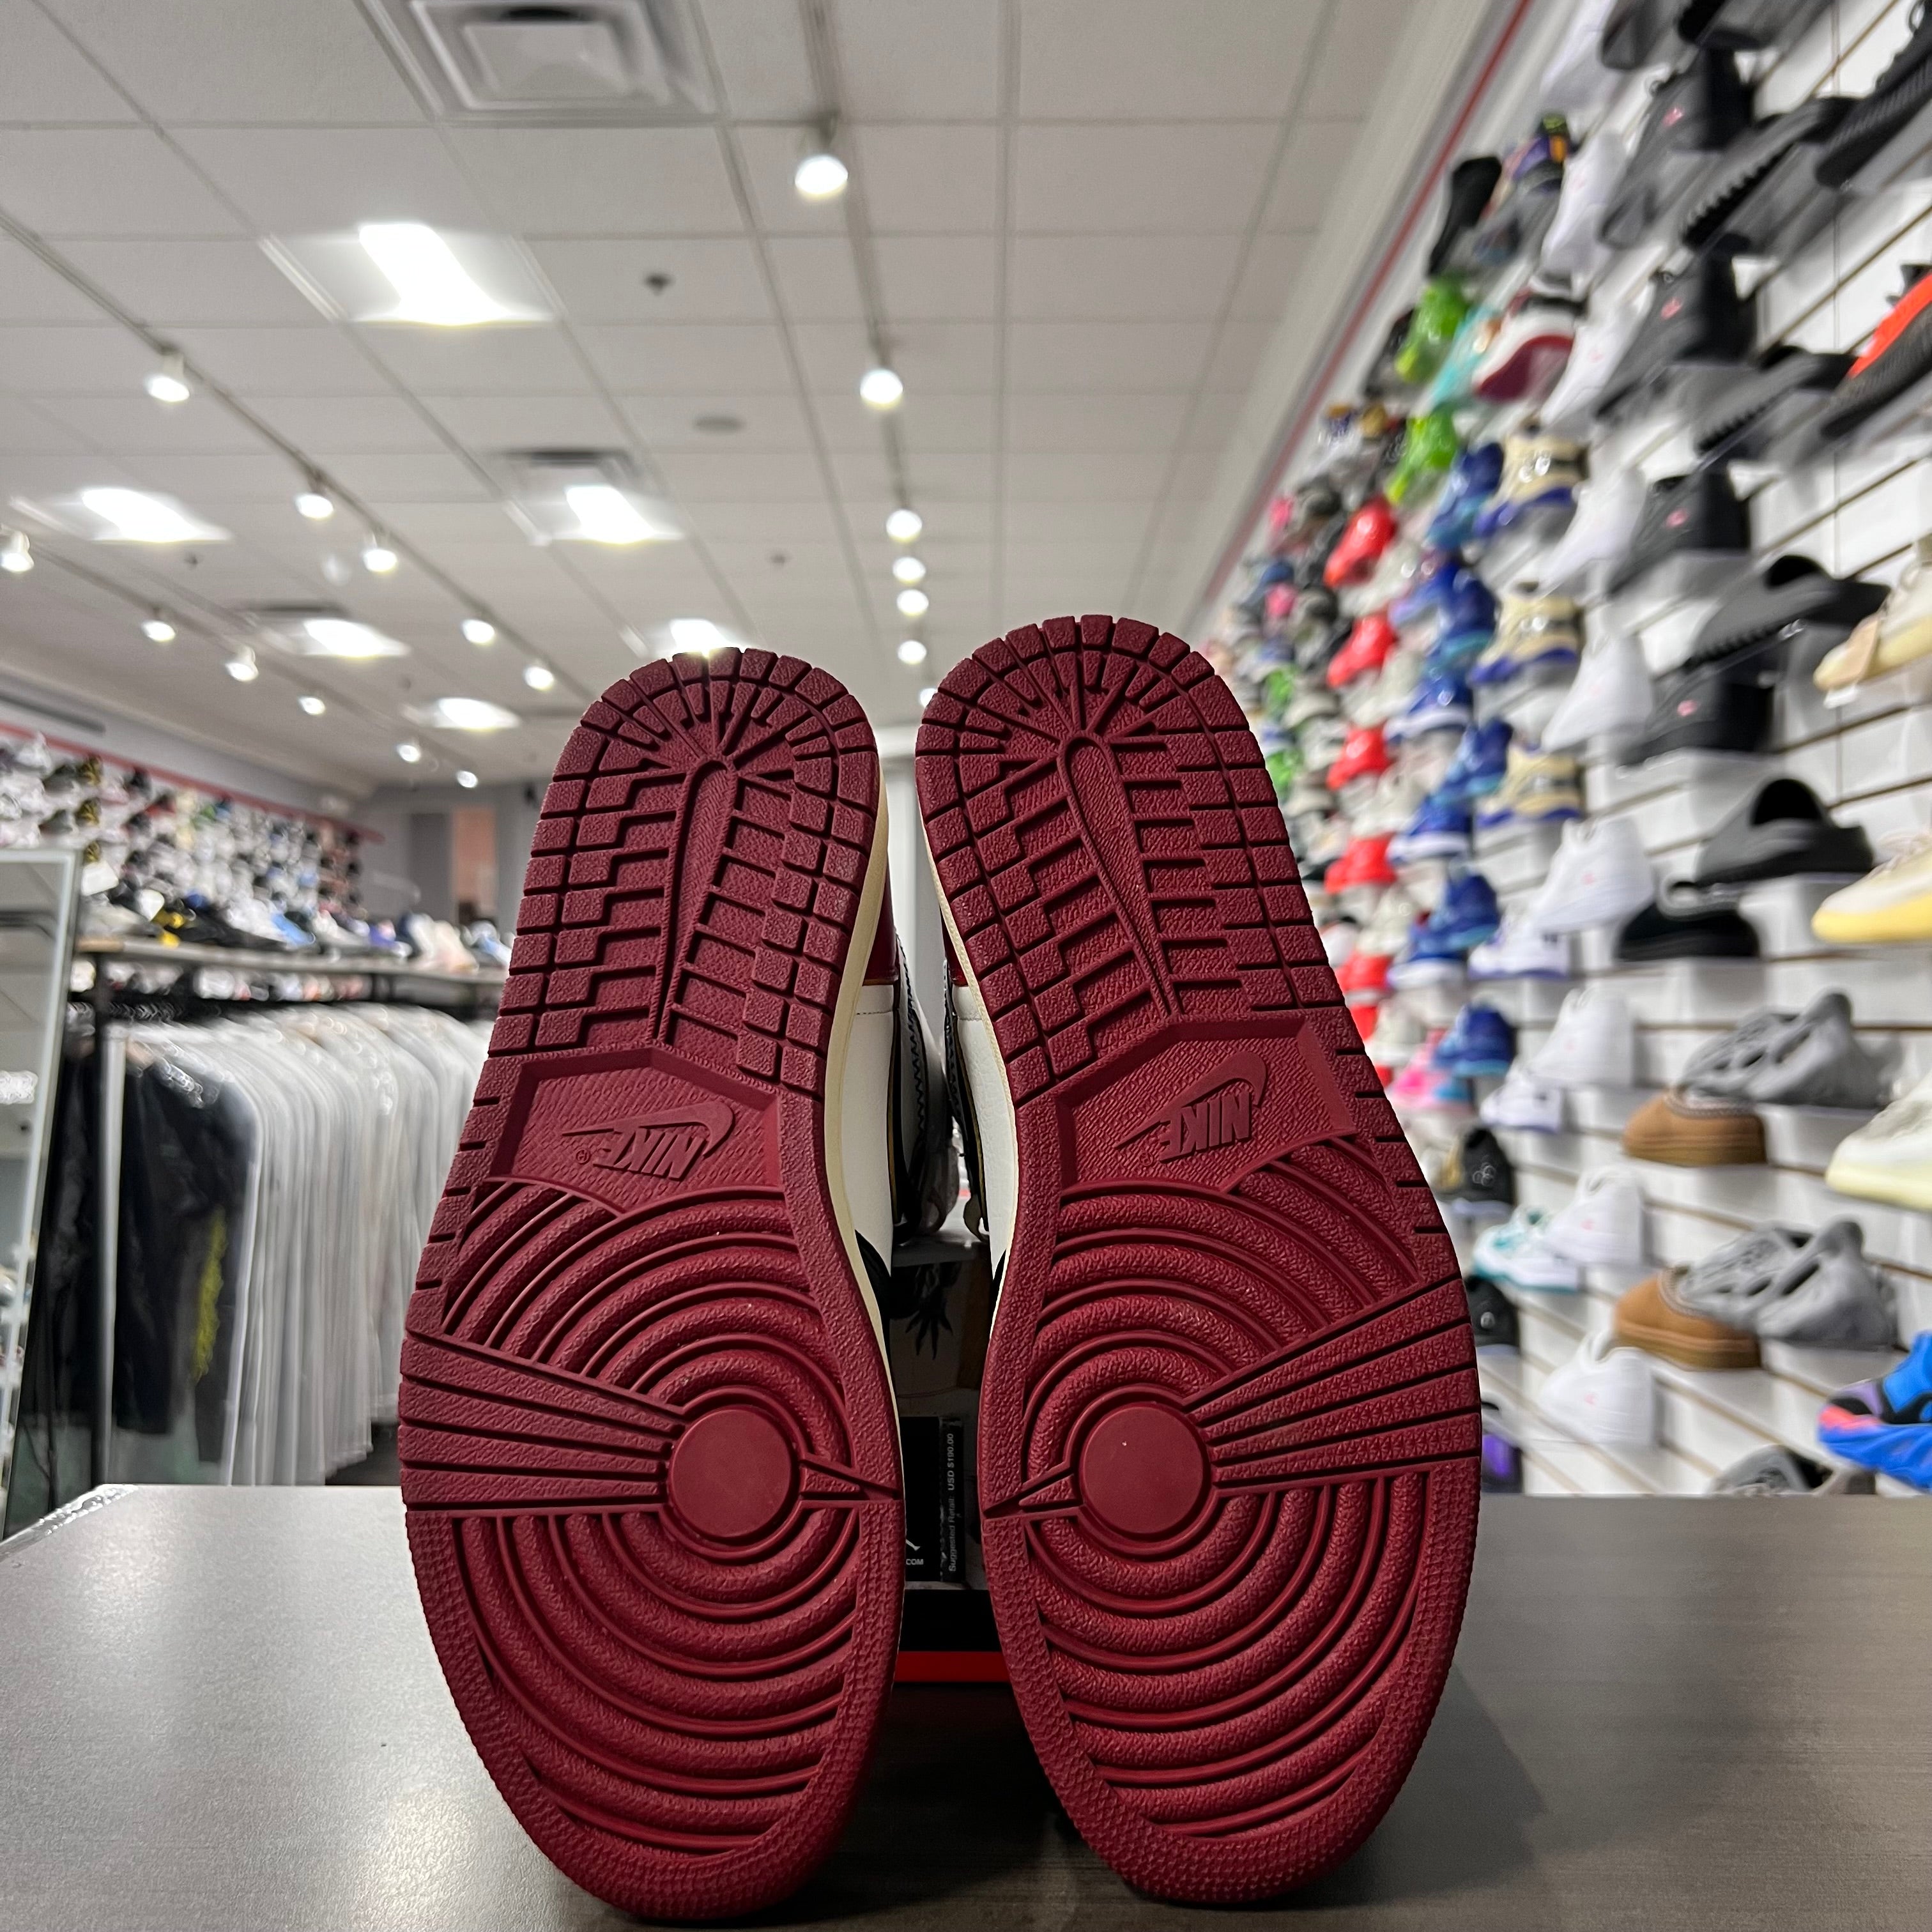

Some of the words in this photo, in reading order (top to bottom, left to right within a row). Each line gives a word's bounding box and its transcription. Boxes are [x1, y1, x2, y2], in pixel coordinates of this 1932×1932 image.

[1160, 1091, 1252, 1163] NIKE
[593, 1128, 705, 1181] NIKE
[947, 1471, 955, 1491] USD
[948, 1526, 957, 1572] Suggested
